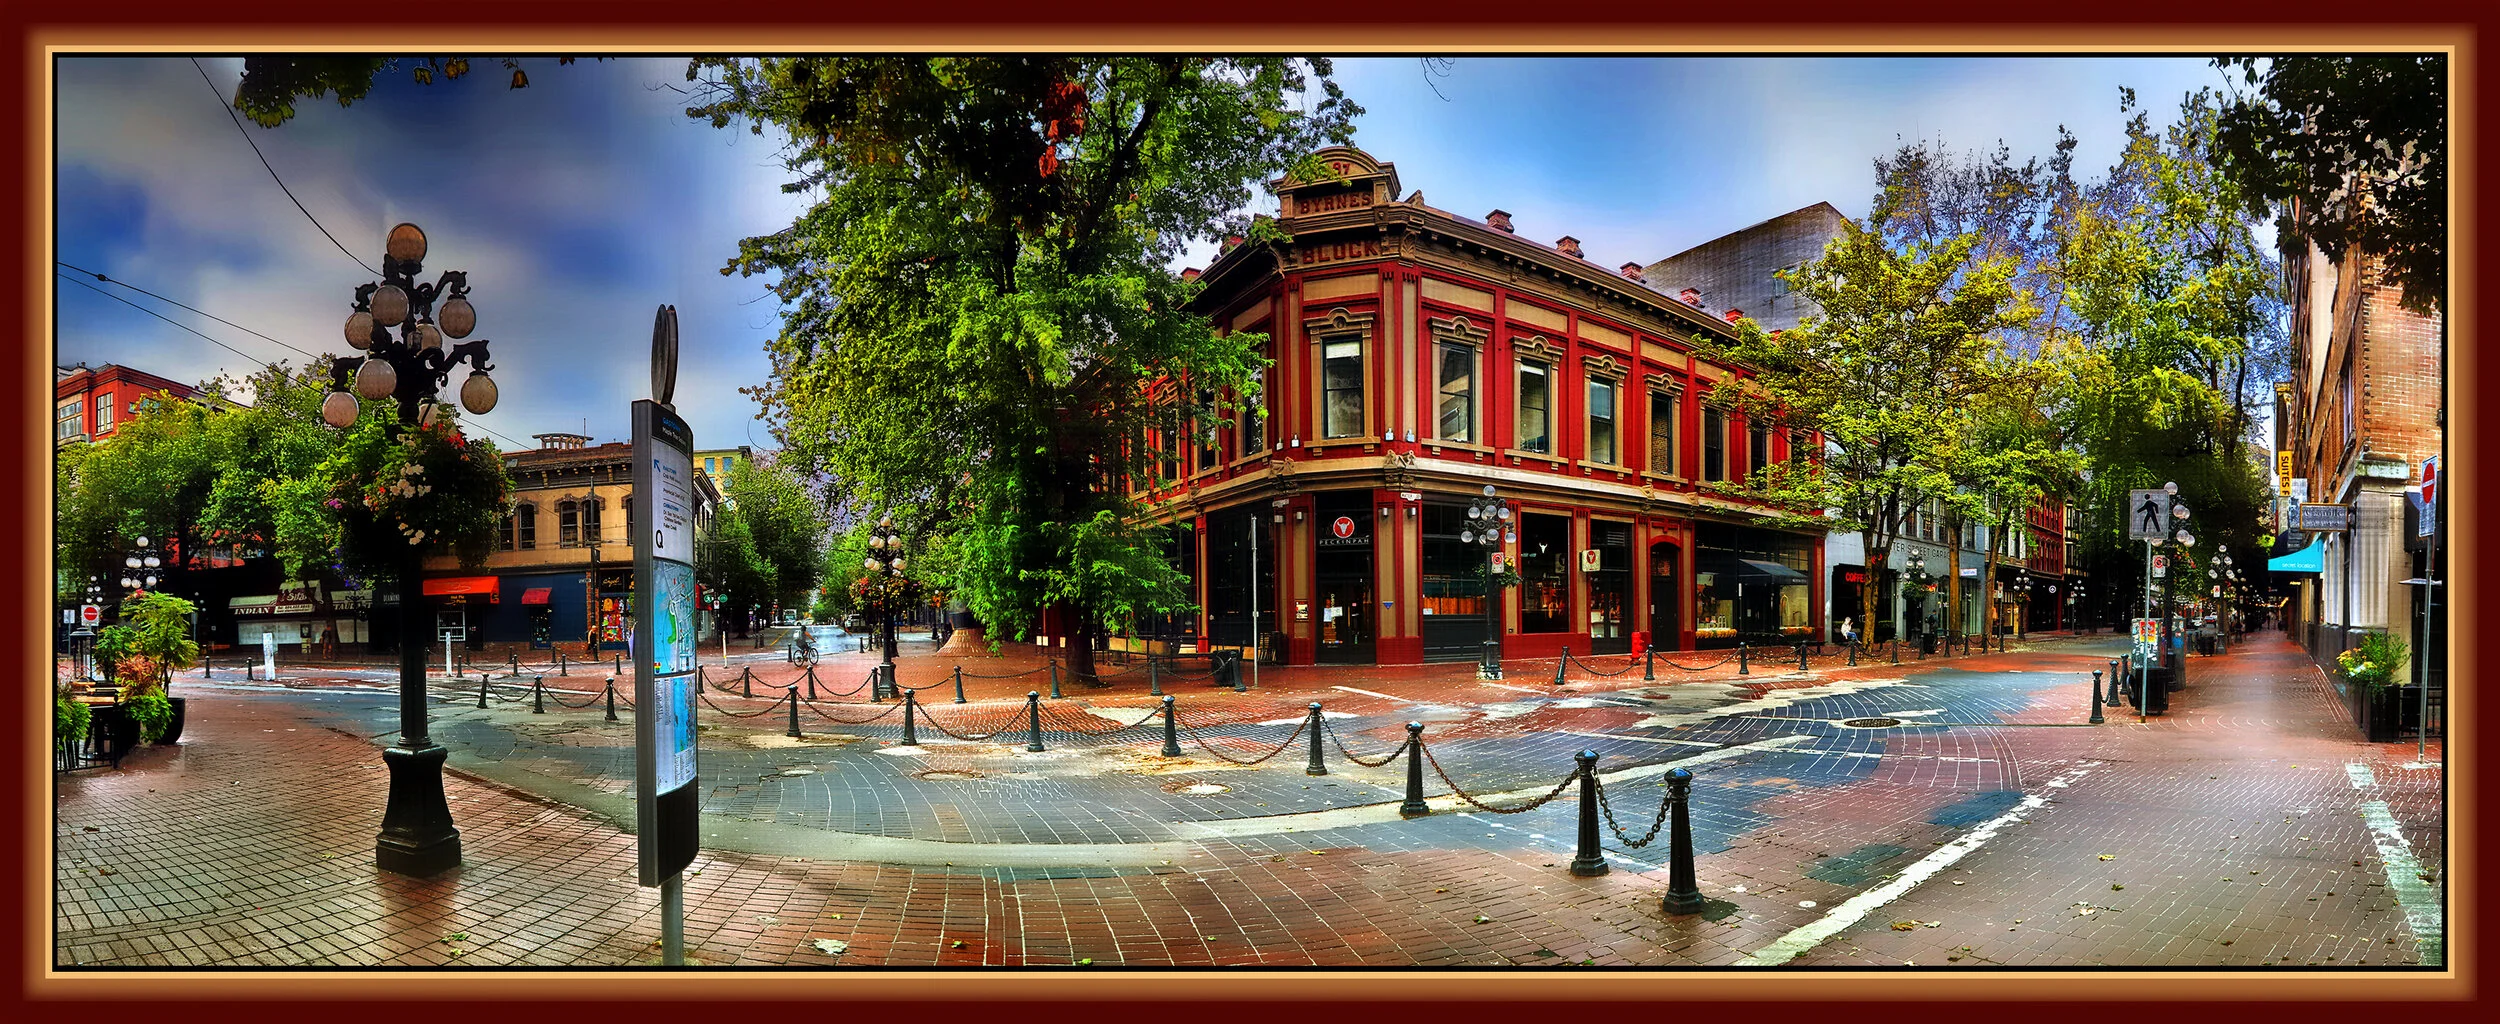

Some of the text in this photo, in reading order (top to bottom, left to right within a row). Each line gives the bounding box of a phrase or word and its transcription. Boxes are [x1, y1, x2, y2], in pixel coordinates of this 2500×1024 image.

[1300, 191, 1373, 215] BYRNES
[1302, 240, 1379, 265] BLOCK
[2281, 456, 2290, 488] SUITES
[655, 529, 664, 549] Q
[234, 606, 270, 616] INDIAN
